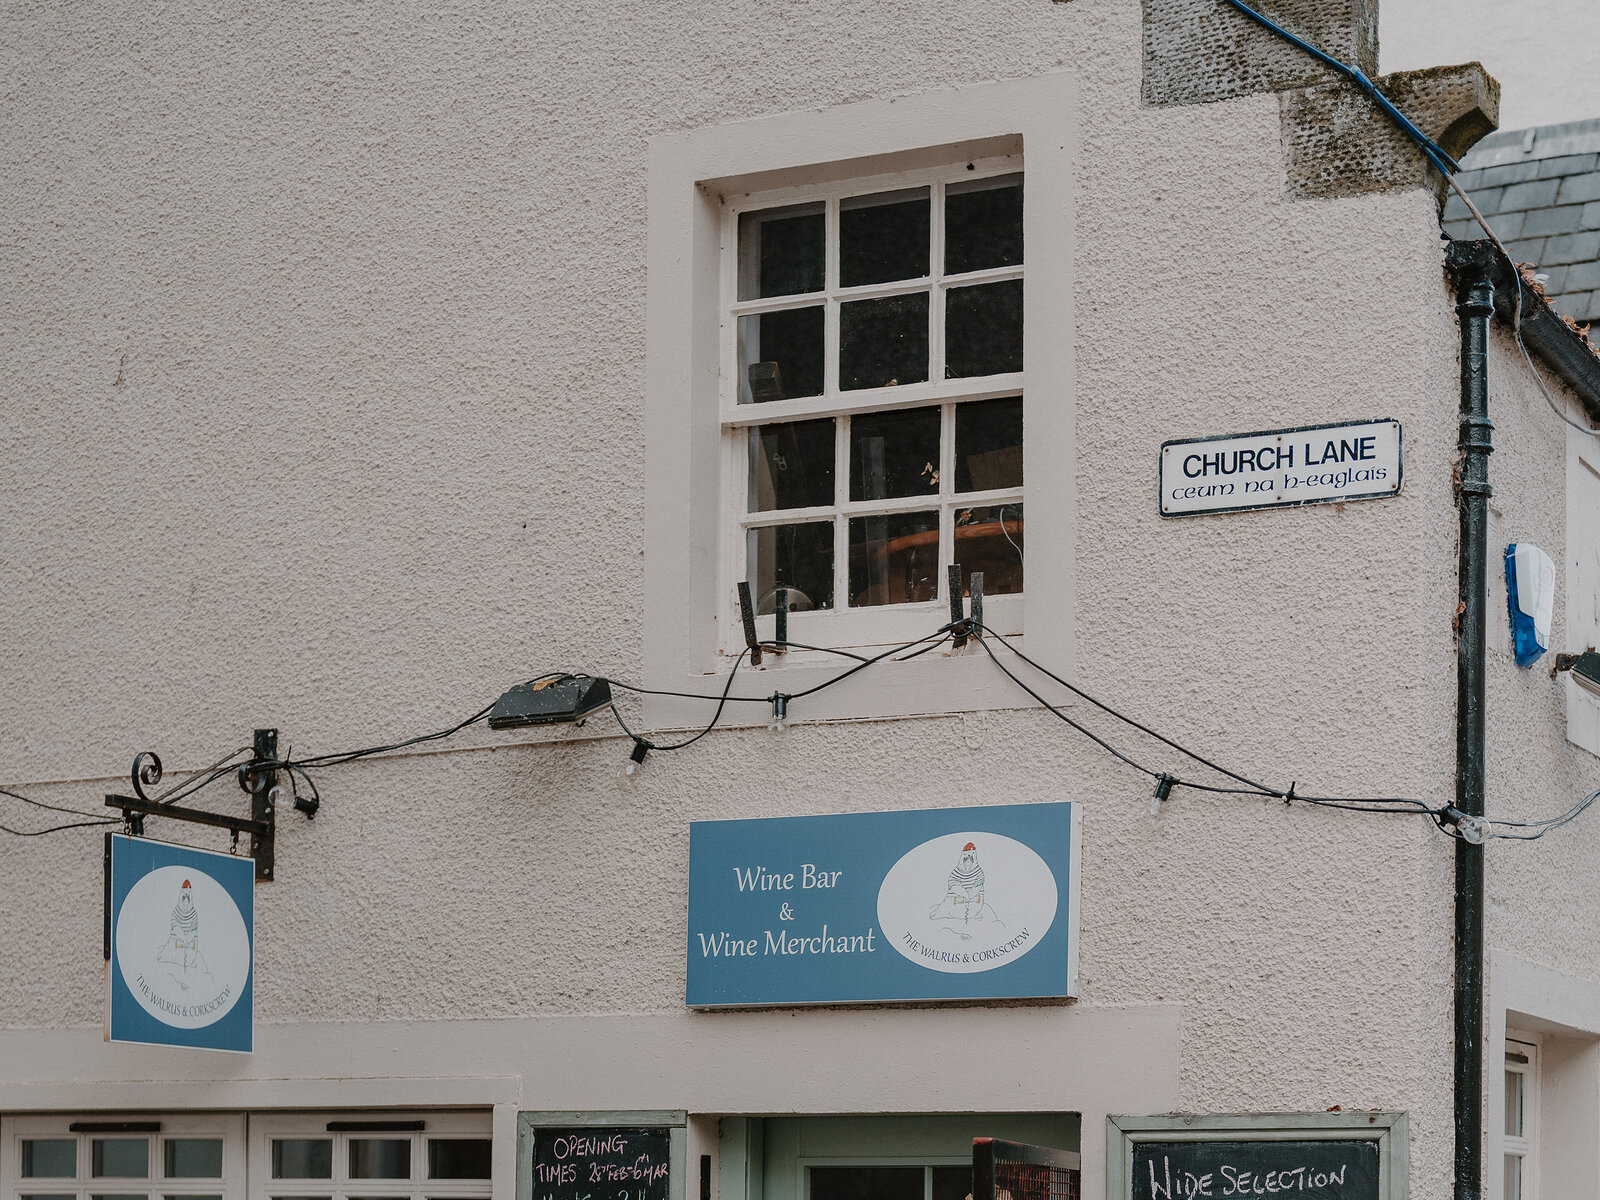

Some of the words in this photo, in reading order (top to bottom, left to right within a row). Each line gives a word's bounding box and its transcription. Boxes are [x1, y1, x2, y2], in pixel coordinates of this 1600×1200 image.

[1183, 445, 1294, 478] CHURCH
[1305, 436, 1377, 466] LANE
[1172, 481, 1235, 500] ceum
[1245, 478, 1274, 493] na
[733, 866, 795, 892] Wine
[800, 863, 843, 889] Bar
[779, 902, 795, 921] &
[697, 931, 758, 957] Wine
[763, 924, 876, 955] Merchant
[902, 931, 920, 951] THE
[920, 945, 960, 963] WALRUS
[962, 953, 971, 963] &
[972, 927, 1030, 963] CORKSCREW
[136, 975, 150, 998] THE
[150, 991, 181, 1016] WALRUS
[181, 1006, 188, 1017] &
[189, 983, 231, 1017] CORKSCREW
[553, 1134, 628, 1159] OPENING
[536, 1163, 577, 1186] TIMES
[1149, 1155, 1213, 1200] WIDE
[1220, 1164, 1347, 1196] SELECTION
